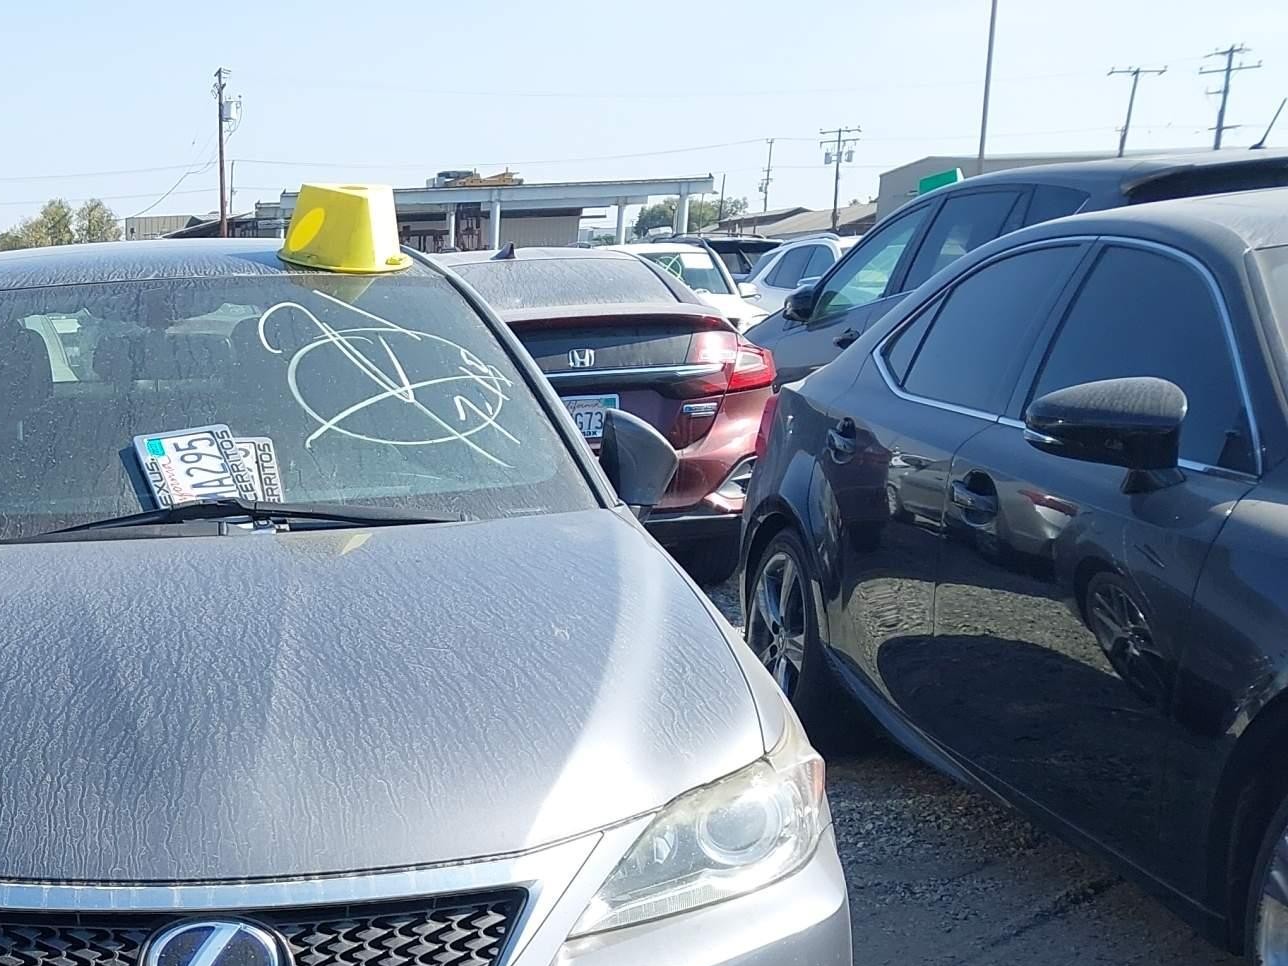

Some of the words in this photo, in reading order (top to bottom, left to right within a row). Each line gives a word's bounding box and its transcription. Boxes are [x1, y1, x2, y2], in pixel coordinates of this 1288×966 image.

[574, 411, 604, 431] G73
[146, 461, 173, 508] EXUS
[216, 429, 258, 502] CERRITOS
[257, 443, 281, 504] ERRITOS
